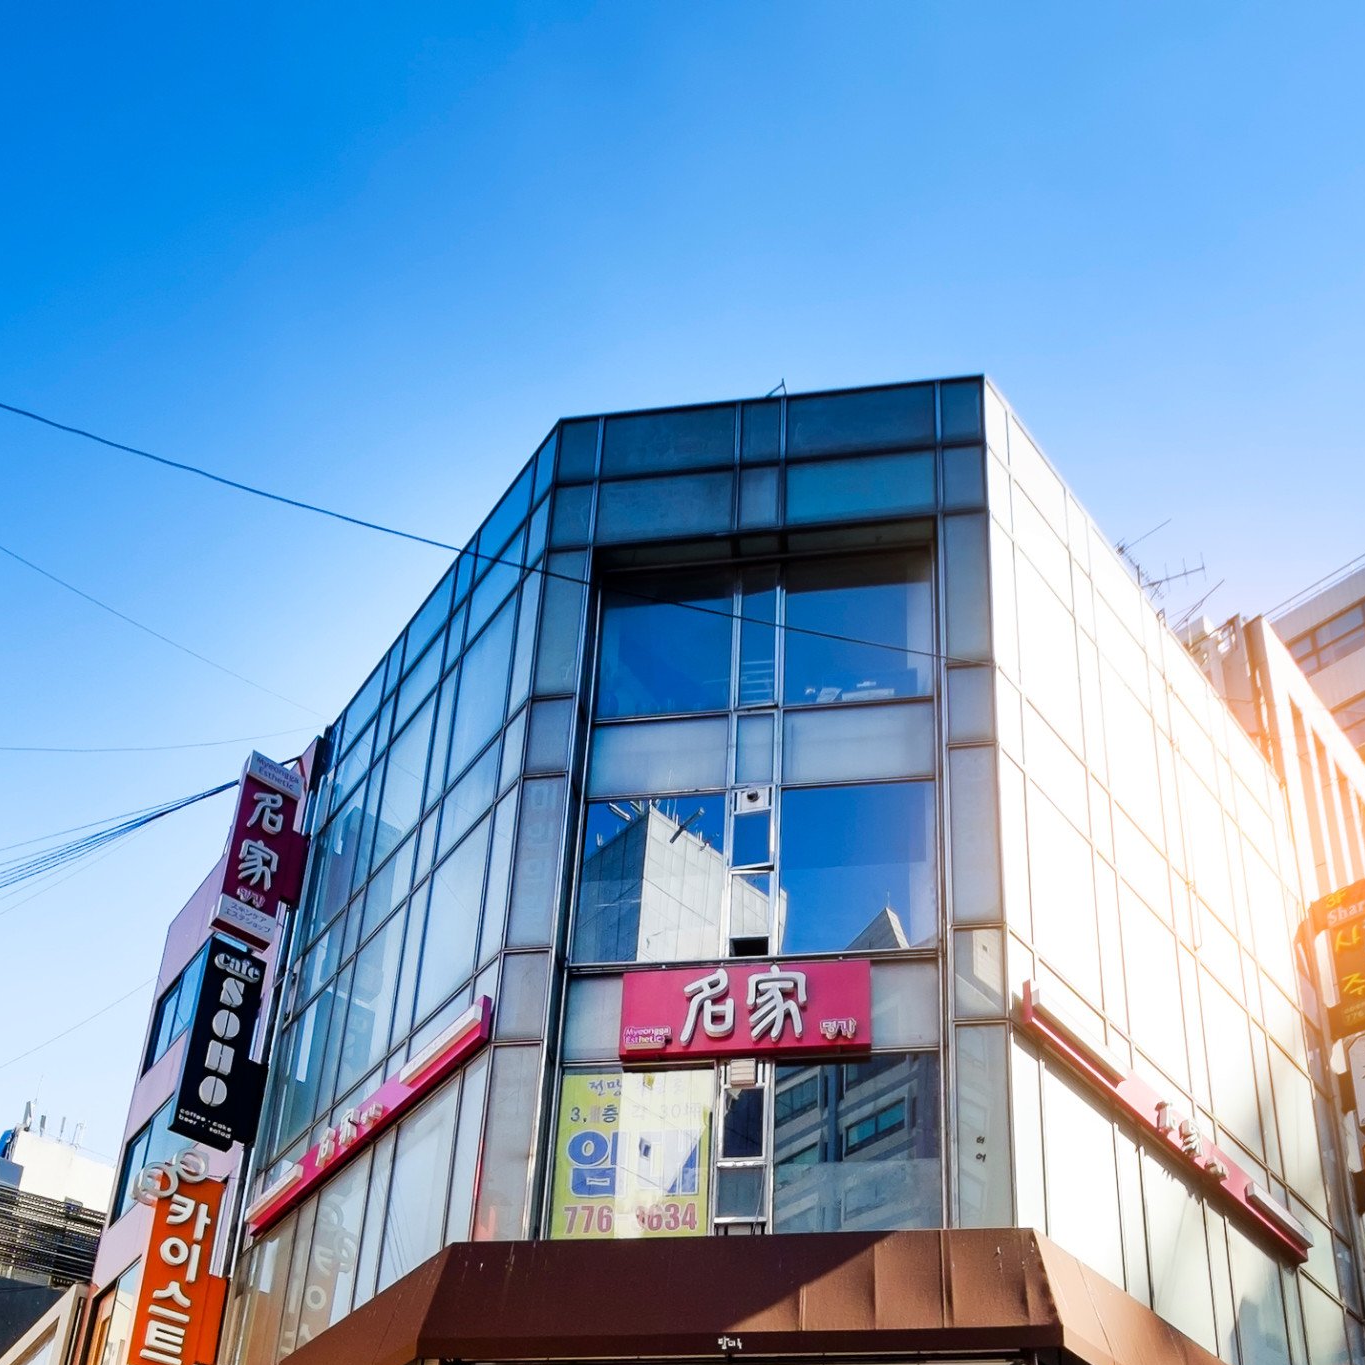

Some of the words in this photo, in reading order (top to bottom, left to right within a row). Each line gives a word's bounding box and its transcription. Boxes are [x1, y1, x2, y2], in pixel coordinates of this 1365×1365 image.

[214, 951, 261, 983] cafe
[680, 963, 808, 1046] 名家
[199, 977, 246, 1108] SOHO
